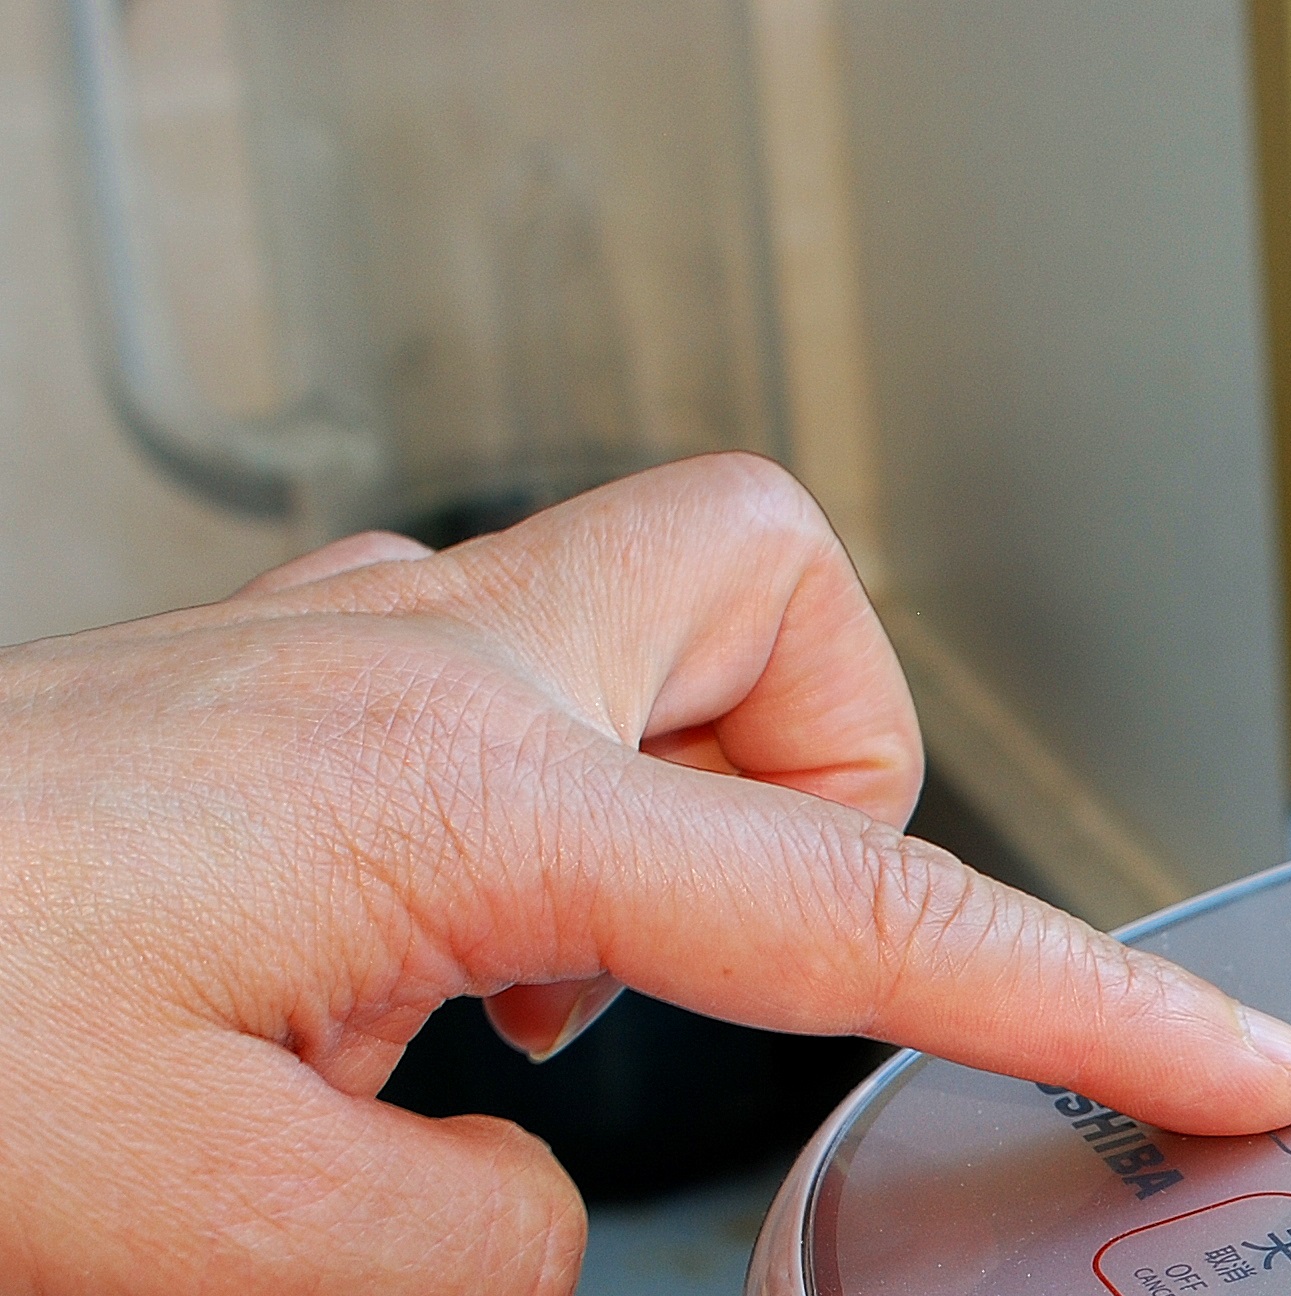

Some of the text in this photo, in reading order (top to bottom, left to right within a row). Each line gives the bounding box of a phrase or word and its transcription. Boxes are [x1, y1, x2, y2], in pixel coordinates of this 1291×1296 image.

[1034, 1081, 1185, 1201] SHIBA
[1165, 1264, 1208, 1290] OFF
[1204, 1245, 1257, 1283] 取消
